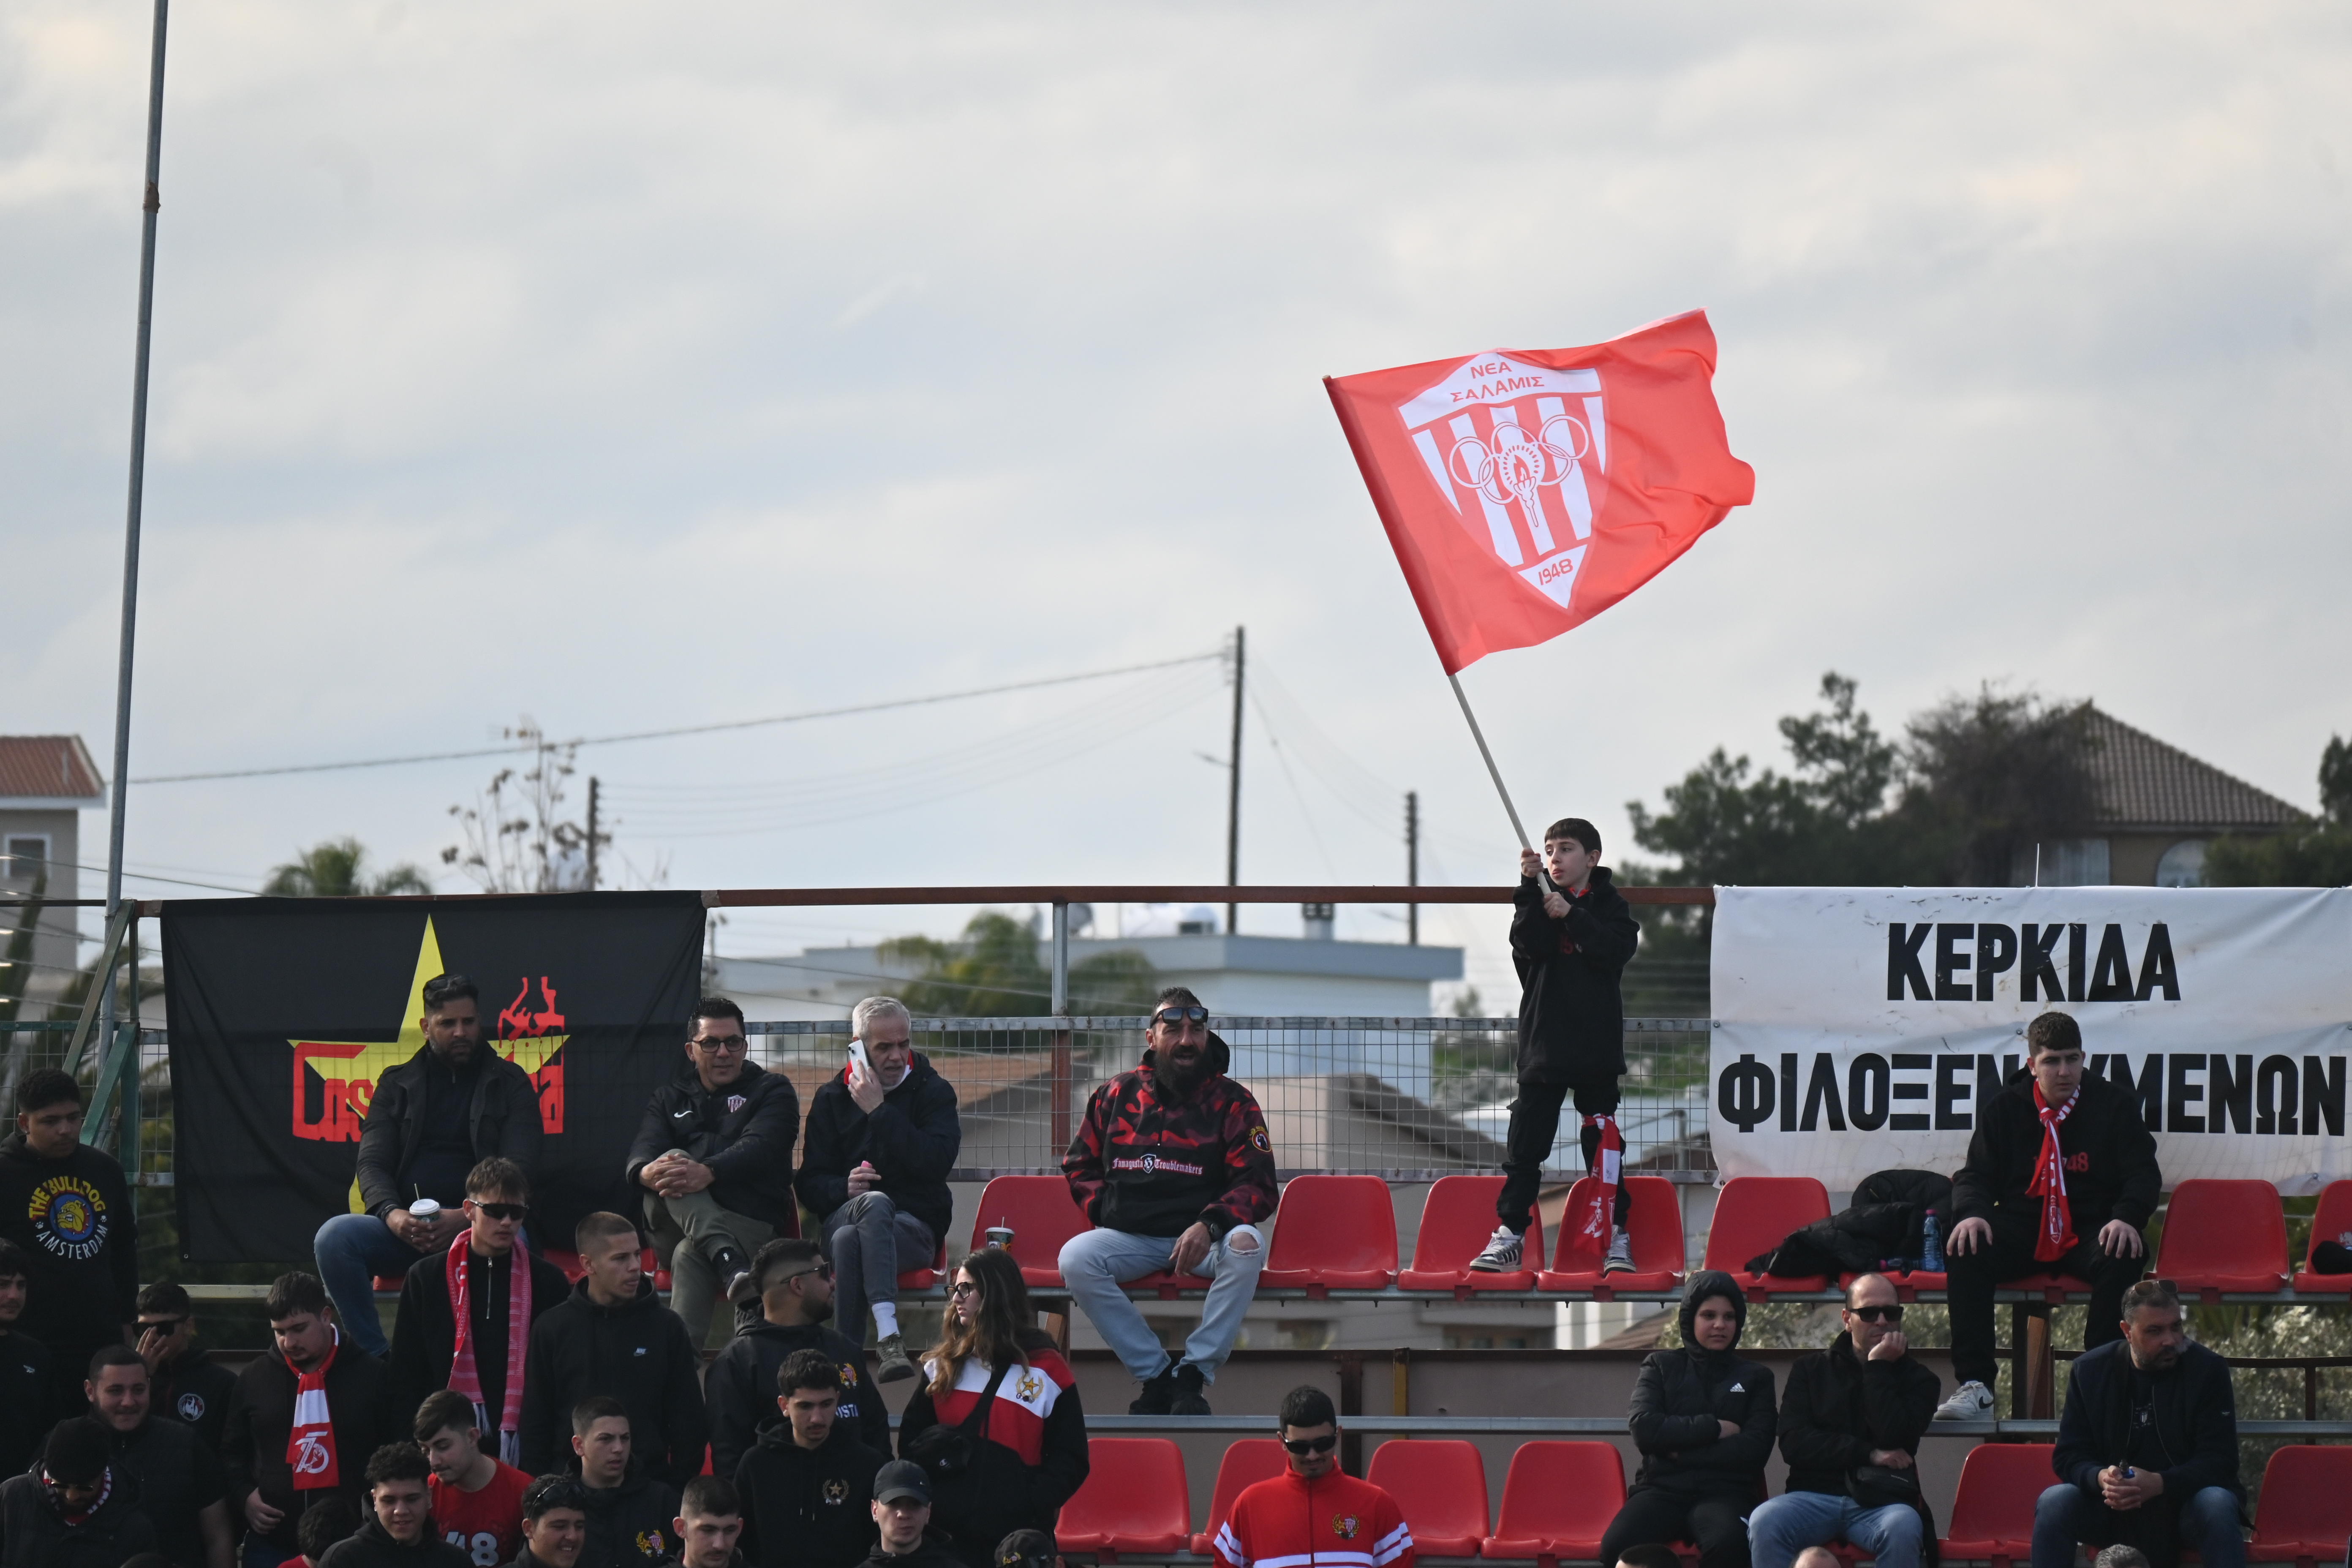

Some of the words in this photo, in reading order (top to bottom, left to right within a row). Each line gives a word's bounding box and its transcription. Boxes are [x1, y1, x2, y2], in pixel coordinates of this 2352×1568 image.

[1470, 362, 1512, 379] ΝΕΑ
[1450, 376, 1544, 403] ΣΑΛΑΜΙΣ
[1538, 558, 1573, 585] 1948
[1887, 923, 2181, 1002] ΚΕΡΚΙΔΑ
[1718, 1053, 2347, 1136] ΦΙΛΟΞΕΝΜΕΝΩΝ
[1113, 1158, 1143, 1169] Famagusta
[1154, 1159, 1203, 1175] Troublemakers
[29, 1187, 51, 1218] THE
[43, 1176, 106, 1211] BULLDOG
[36, 1225, 108, 1260] AMSTERDAM
[295, 1431, 329, 1474] 75
